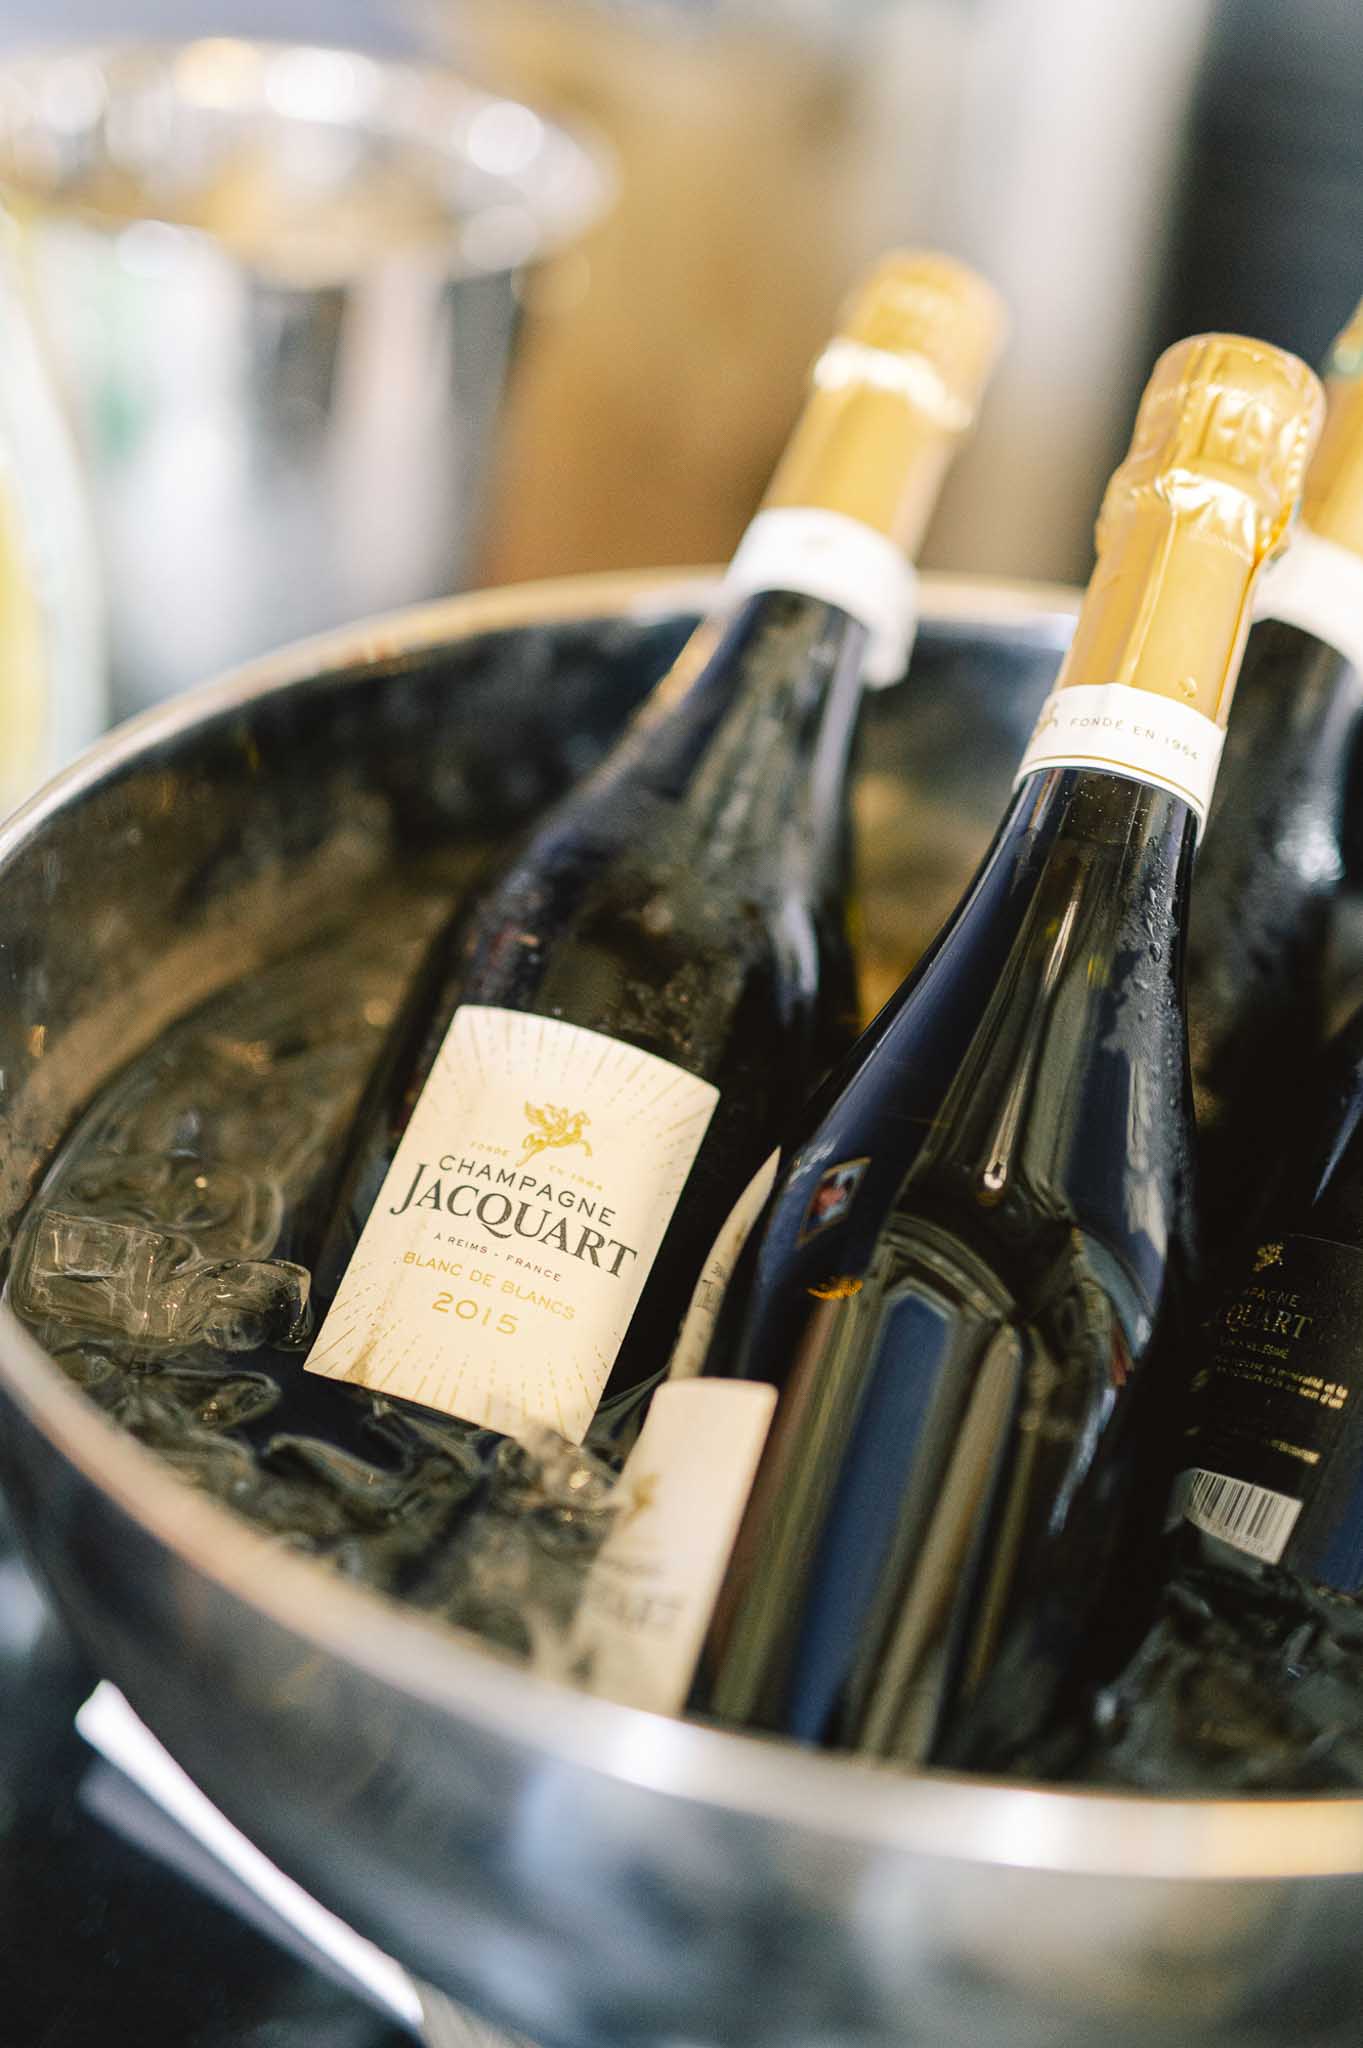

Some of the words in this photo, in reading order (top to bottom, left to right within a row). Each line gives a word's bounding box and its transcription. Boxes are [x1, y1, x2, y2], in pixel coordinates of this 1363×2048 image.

[1133, 727, 1156, 740] EN
[439, 1154, 616, 1227] CHAMPAGNE
[390, 1163, 638, 1279] JACQUART
[403, 1250, 463, 1278] BLANC
[469, 1269, 496, 1288] DE
[501, 1280, 576, 1320] BLANCS
[447, 1236, 488, 1254] REIMS
[505, 1254, 562, 1282] FRANCE
[431, 1292, 520, 1336] 2015
